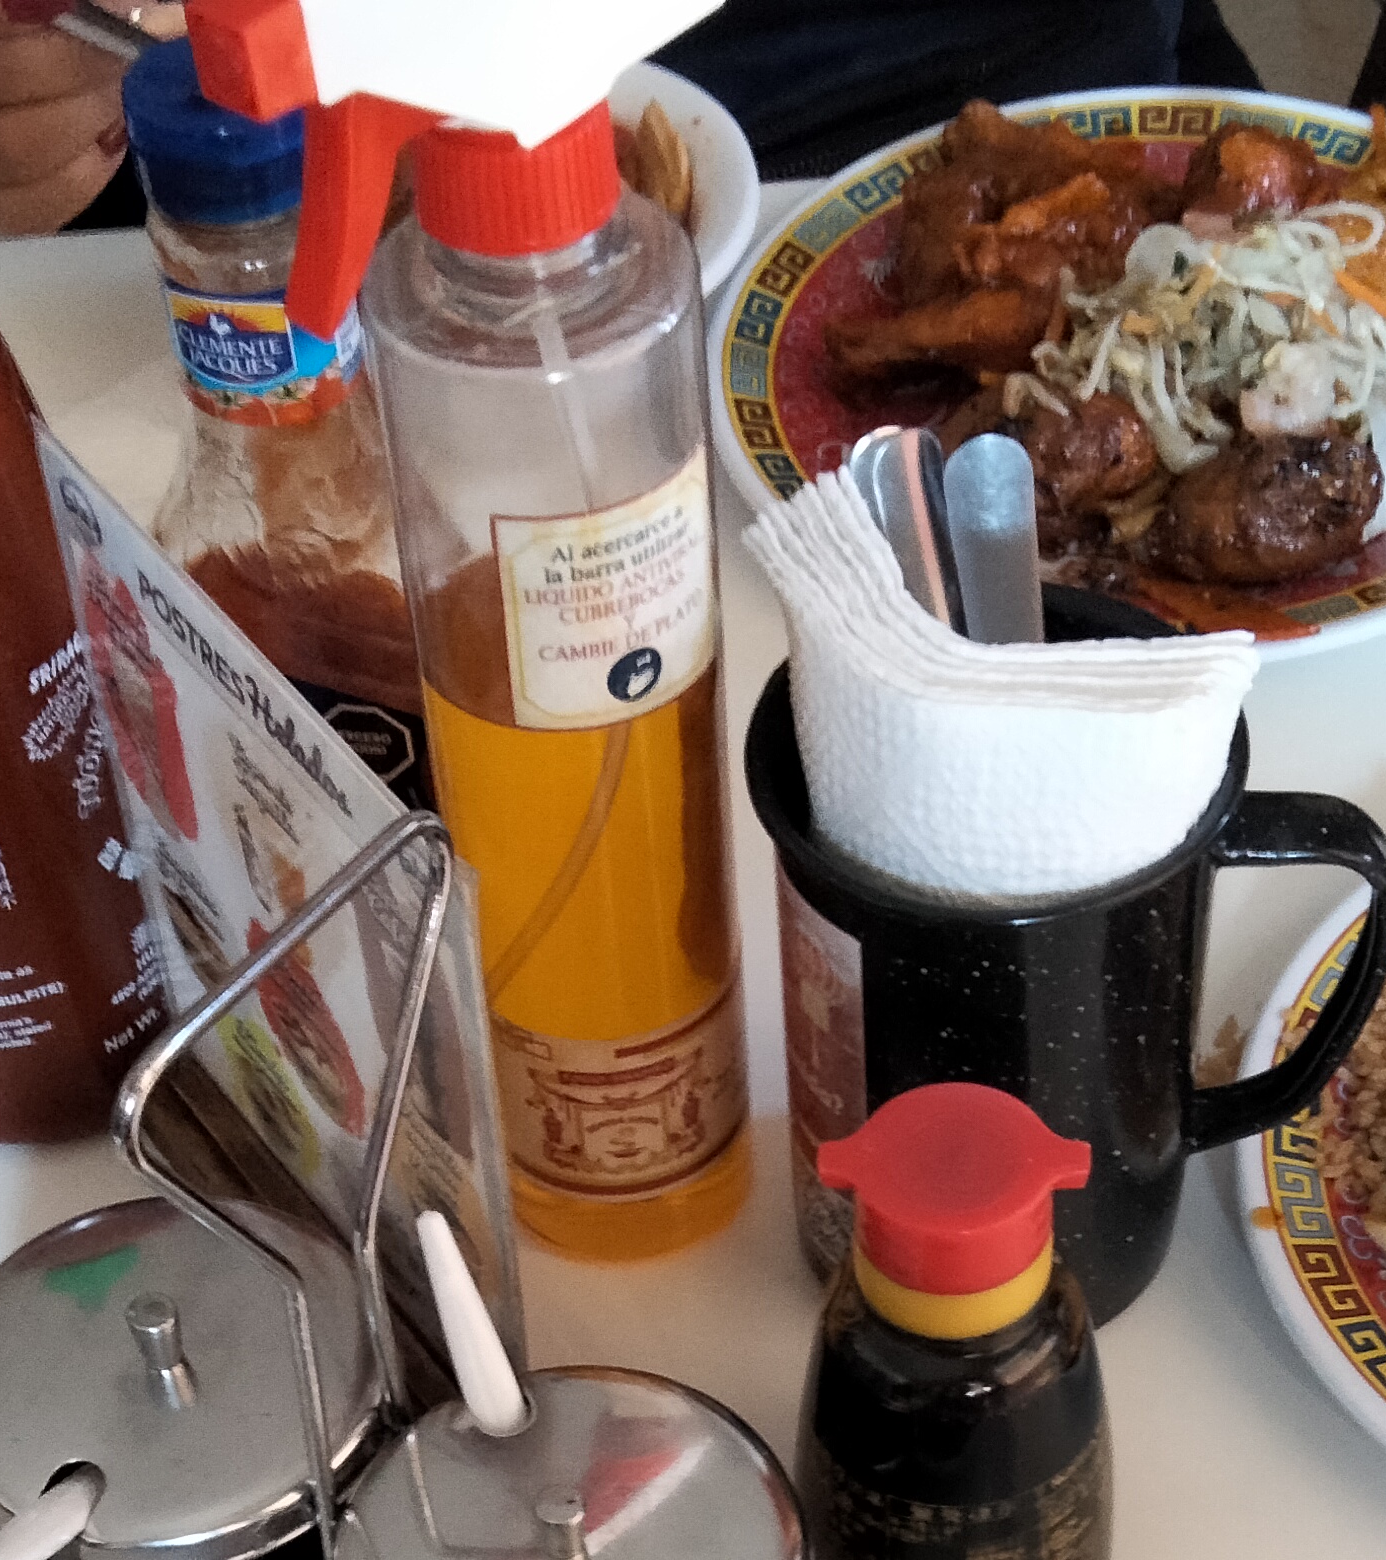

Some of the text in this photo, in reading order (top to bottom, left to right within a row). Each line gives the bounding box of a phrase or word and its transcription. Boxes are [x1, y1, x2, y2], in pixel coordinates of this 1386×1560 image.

[177, 323, 284, 357] CLEMENTE
[190, 346, 279, 377] JACQUES
[552, 542, 574, 565] Al
[544, 566, 563, 585] la
[570, 558, 625, 583] barra
[523, 582, 613, 605] LIQUIDO
[558, 569, 686, 626] CUBREBOCAS
[137, 567, 246, 706] POSTRES
[537, 640, 618, 664] CAMBIE
